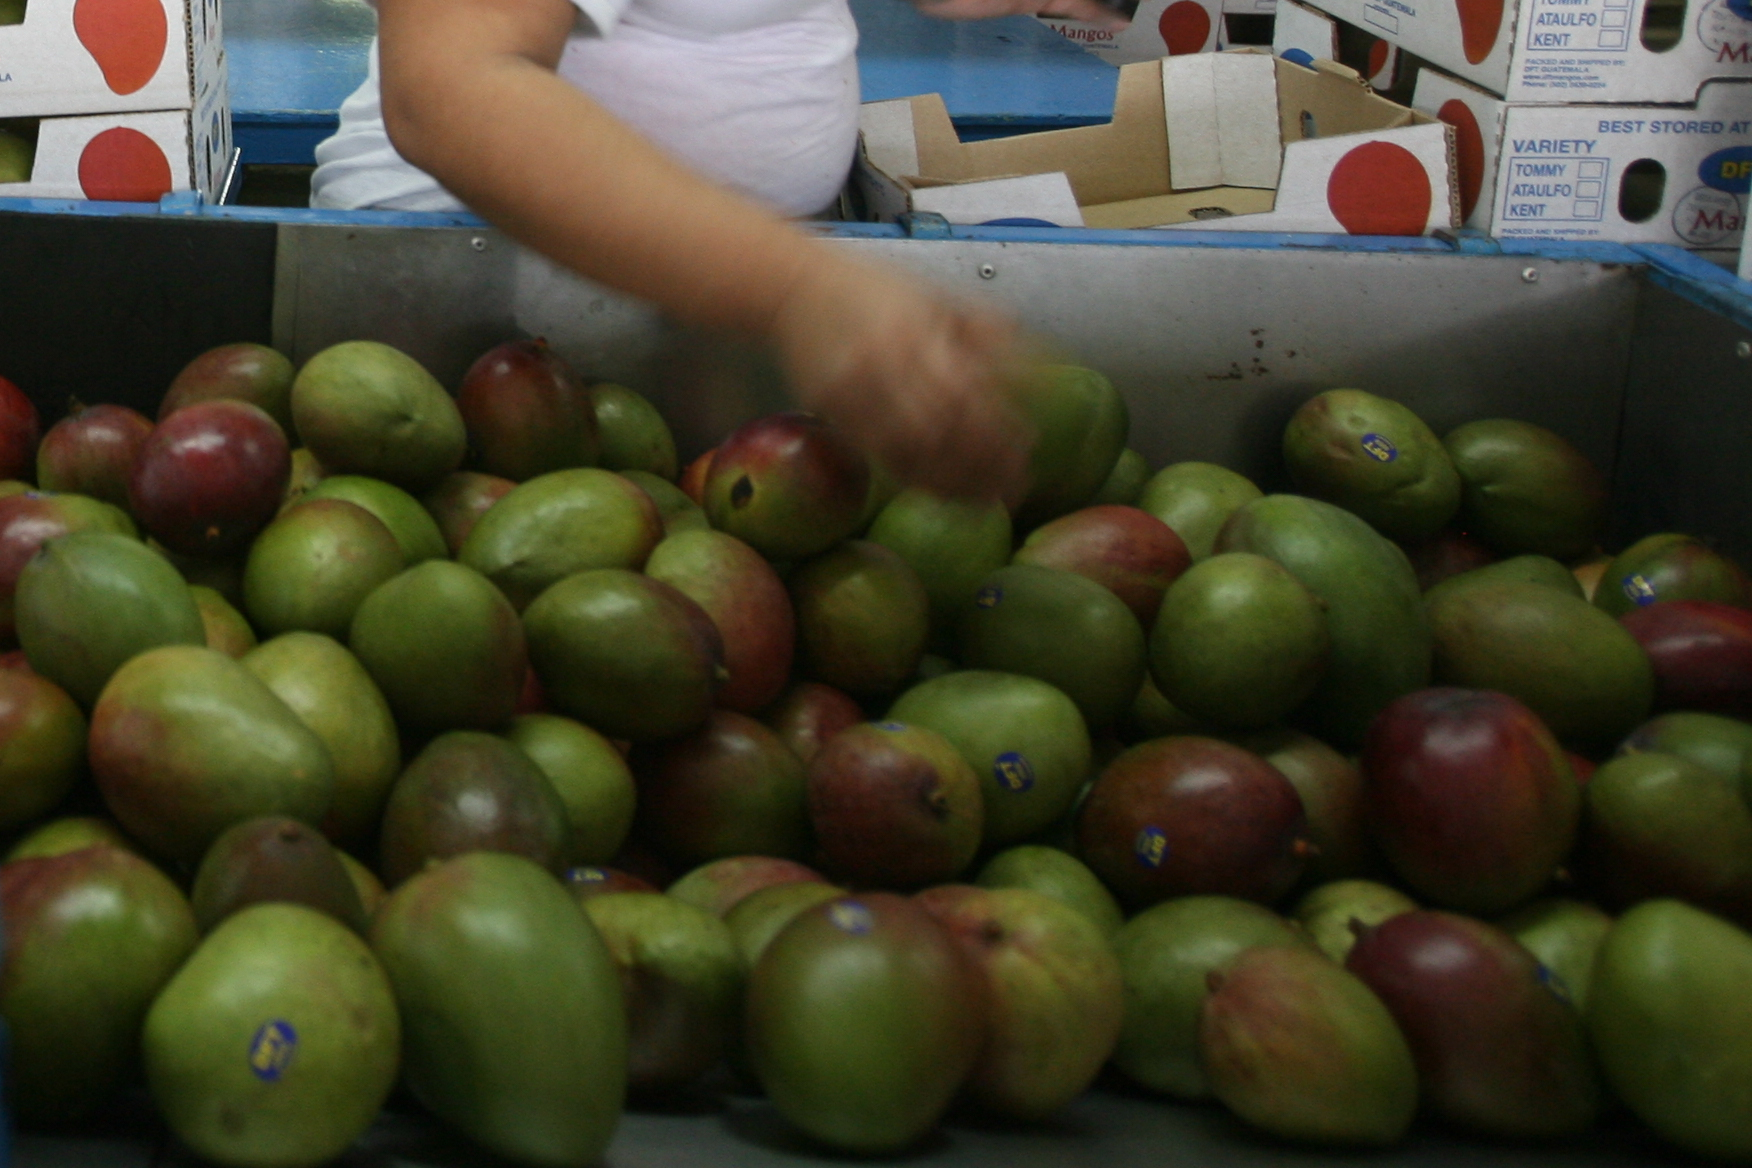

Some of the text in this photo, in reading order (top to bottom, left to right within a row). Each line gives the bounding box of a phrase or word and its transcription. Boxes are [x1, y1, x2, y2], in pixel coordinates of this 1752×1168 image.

[1536, 12, 1597, 27] ATAULFO
[1534, 33, 1571, 47] KENT
[1598, 120, 1645, 134] BEST
[1651, 120, 1725, 134] STORED
[1513, 139, 1596, 154] VARIETY
[1516, 163, 1565, 177] TOMMY
[1512, 183, 1572, 197] ATAULFO
[1510, 203, 1546, 217] KENT
